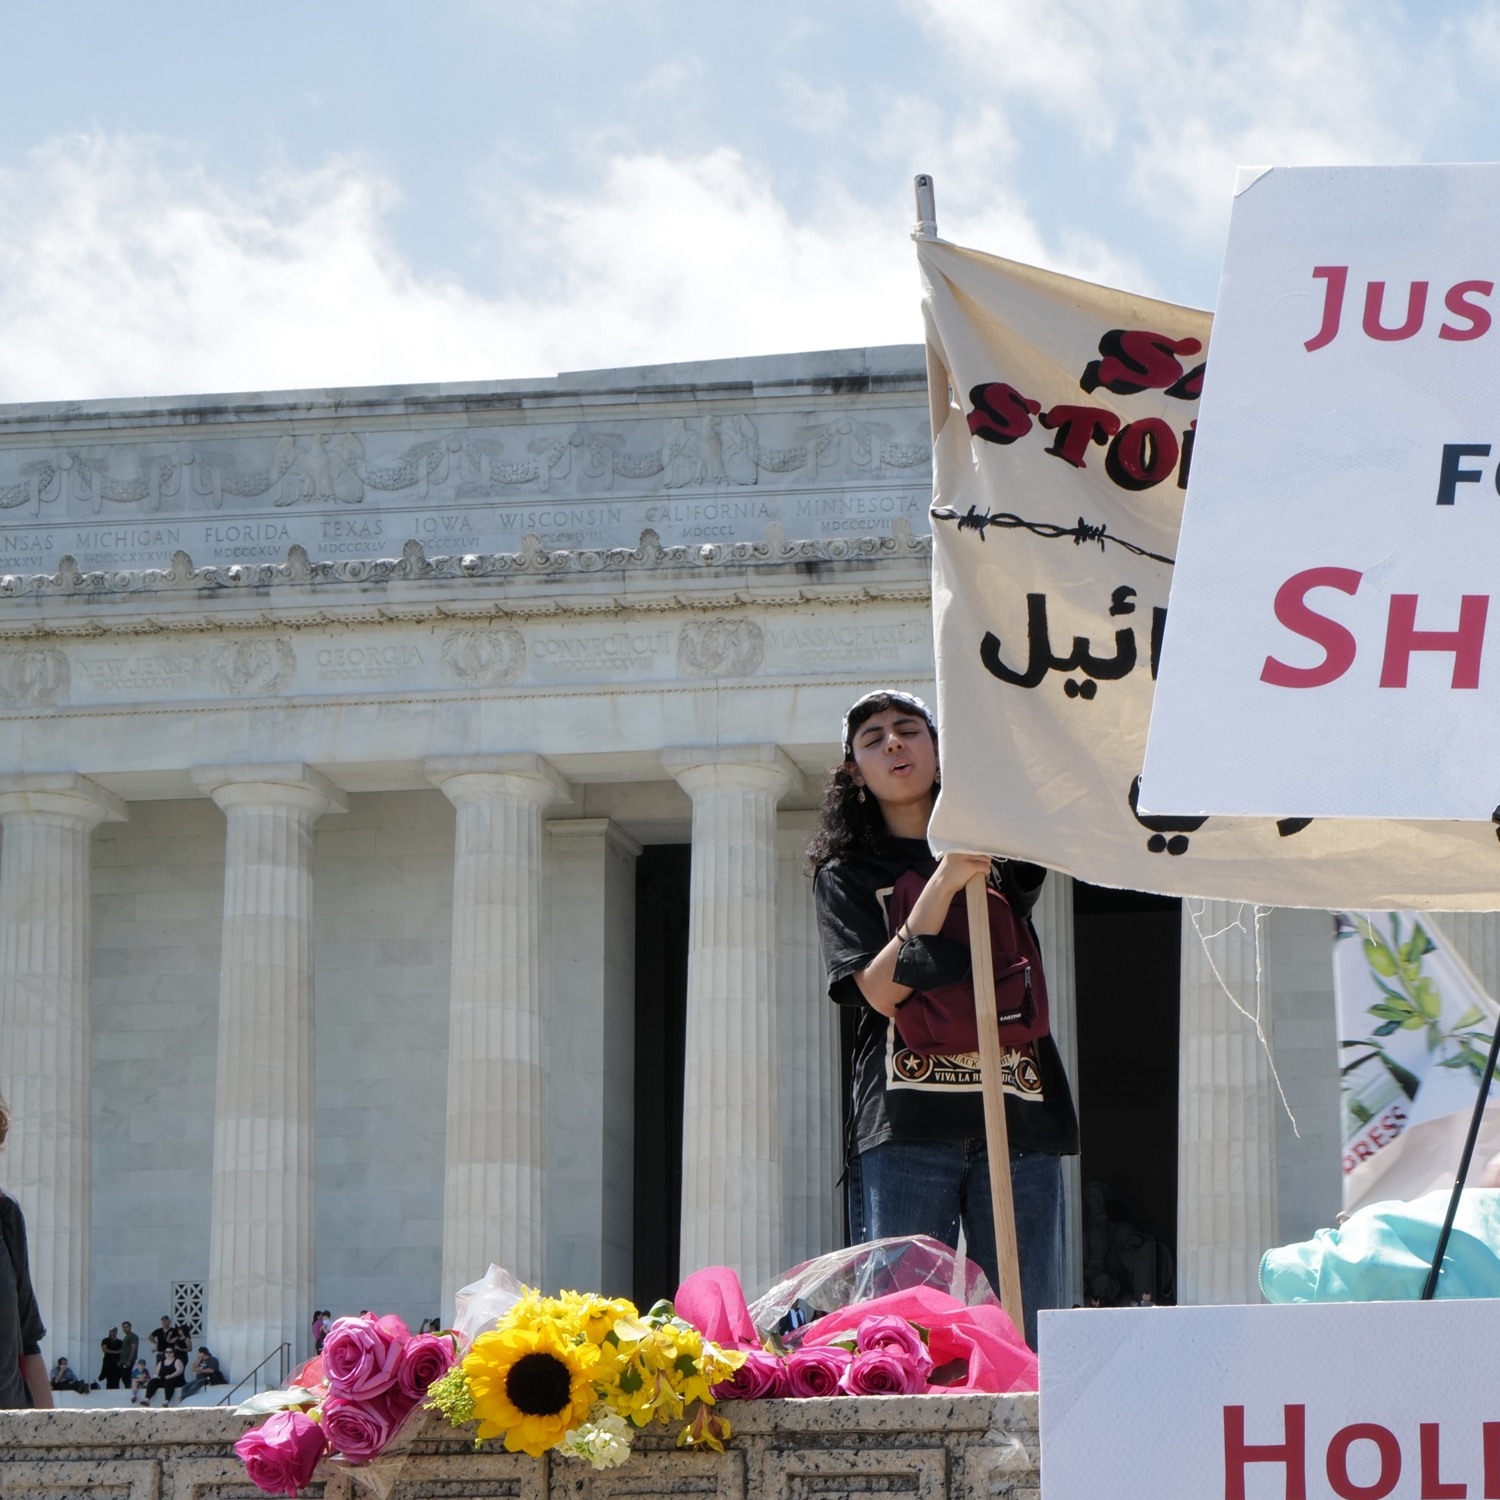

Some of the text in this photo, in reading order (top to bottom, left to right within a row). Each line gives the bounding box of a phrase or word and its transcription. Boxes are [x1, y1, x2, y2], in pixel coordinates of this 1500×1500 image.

[966, 382, 1197, 491] STO
[0, 497, 920, 552] NSAS MICHIGAN FLORIDA TEXAS IOWA WISCONSIN CALIFORNIA MINNESOTA
[214, 546, 281, 558] MDCCCXLV
[318, 541, 386, 553] MDCCCXLV
[418, 537, 480, 548] DCCCXLVI
[682, 525, 735, 537] MDCCCL
[76, 657, 128, 678] NEW
[316, 645, 425, 668] GEORGIA
[530, 631, 674, 658] CONNECTICUT
[767, 622, 928, 648] MASSACHUSETTS
[935, 1072, 956, 1082] VIVA
[958, 1073, 970, 1082] LA
